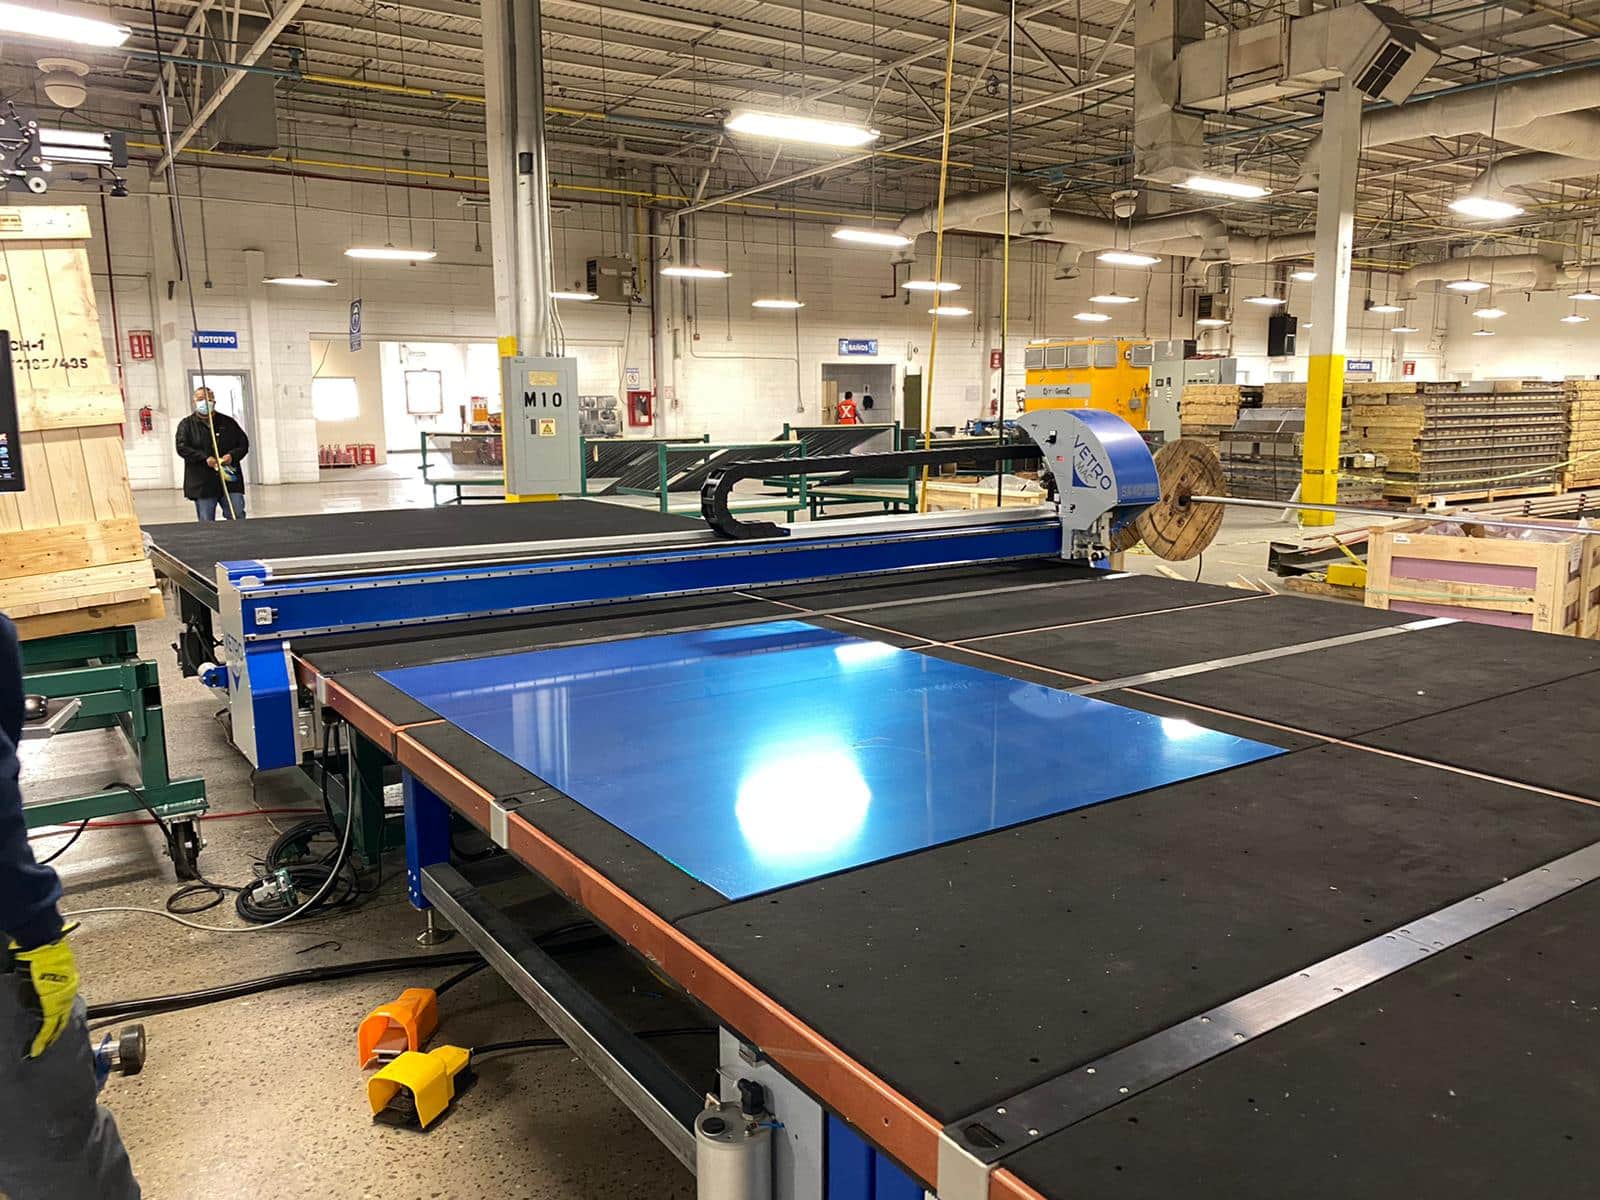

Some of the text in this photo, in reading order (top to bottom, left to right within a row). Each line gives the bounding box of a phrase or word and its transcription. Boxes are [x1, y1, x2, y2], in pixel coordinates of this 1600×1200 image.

[524, 391, 562, 408] M10
[1074, 434, 1112, 490] VETRO
[1076, 462, 1094, 483] MAC
